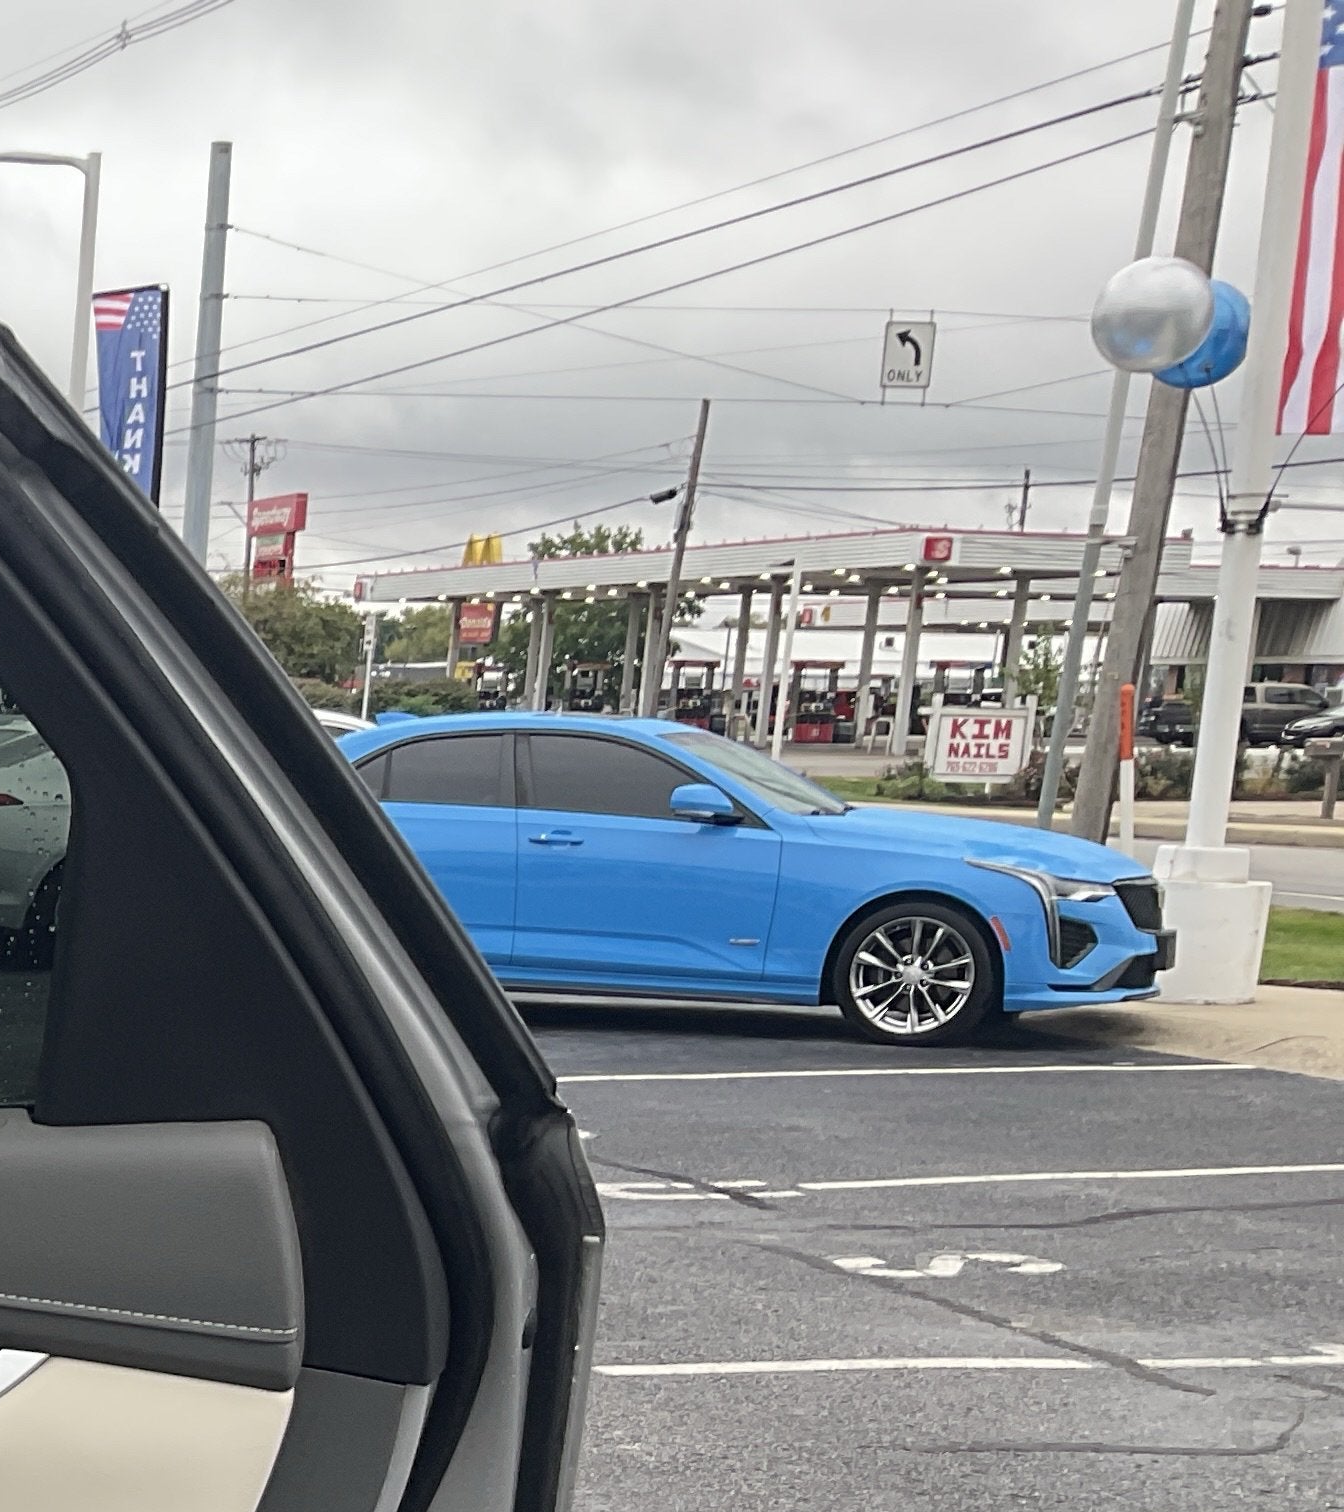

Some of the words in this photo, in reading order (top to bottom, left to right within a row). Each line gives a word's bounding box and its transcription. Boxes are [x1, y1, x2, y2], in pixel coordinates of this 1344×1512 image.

[887, 368, 923, 383] ONLY
[950, 718, 1013, 740] KIM
[947, 743, 1010, 759] NAILS
